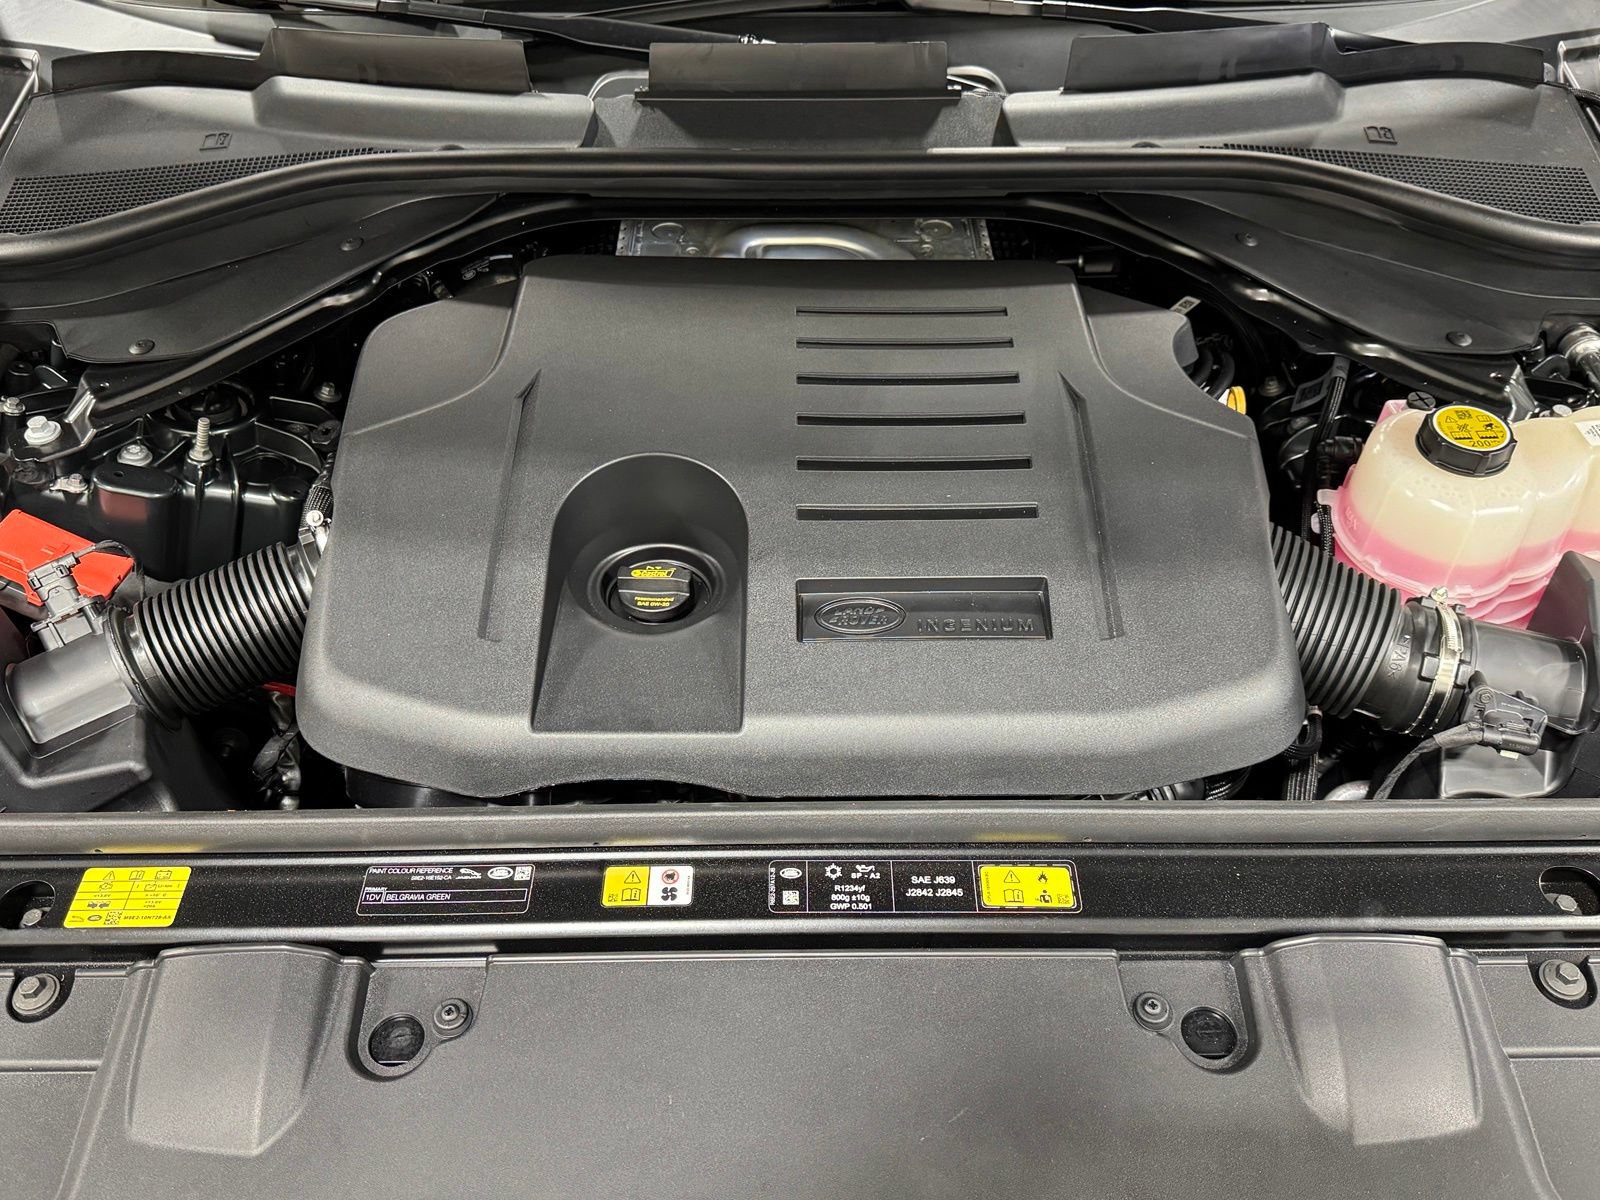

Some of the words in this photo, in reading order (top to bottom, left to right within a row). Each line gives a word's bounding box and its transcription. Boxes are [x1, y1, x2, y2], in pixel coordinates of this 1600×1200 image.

[918, 617, 1034, 633] INGENIUM
[910, 875, 932, 884] SAE
[933, 875, 956, 884] J639
[834, 884, 866, 893] R1234yf
[905, 888, 934, 897] J2842
[935, 888, 964, 897] J2845
[366, 893, 381, 901] 1DV
[386, 893, 425, 901] BELGRAVIA
[426, 893, 451, 901] GREEN
[831, 893, 850, 902] 800g
[851, 902, 872, 910] 0.501
